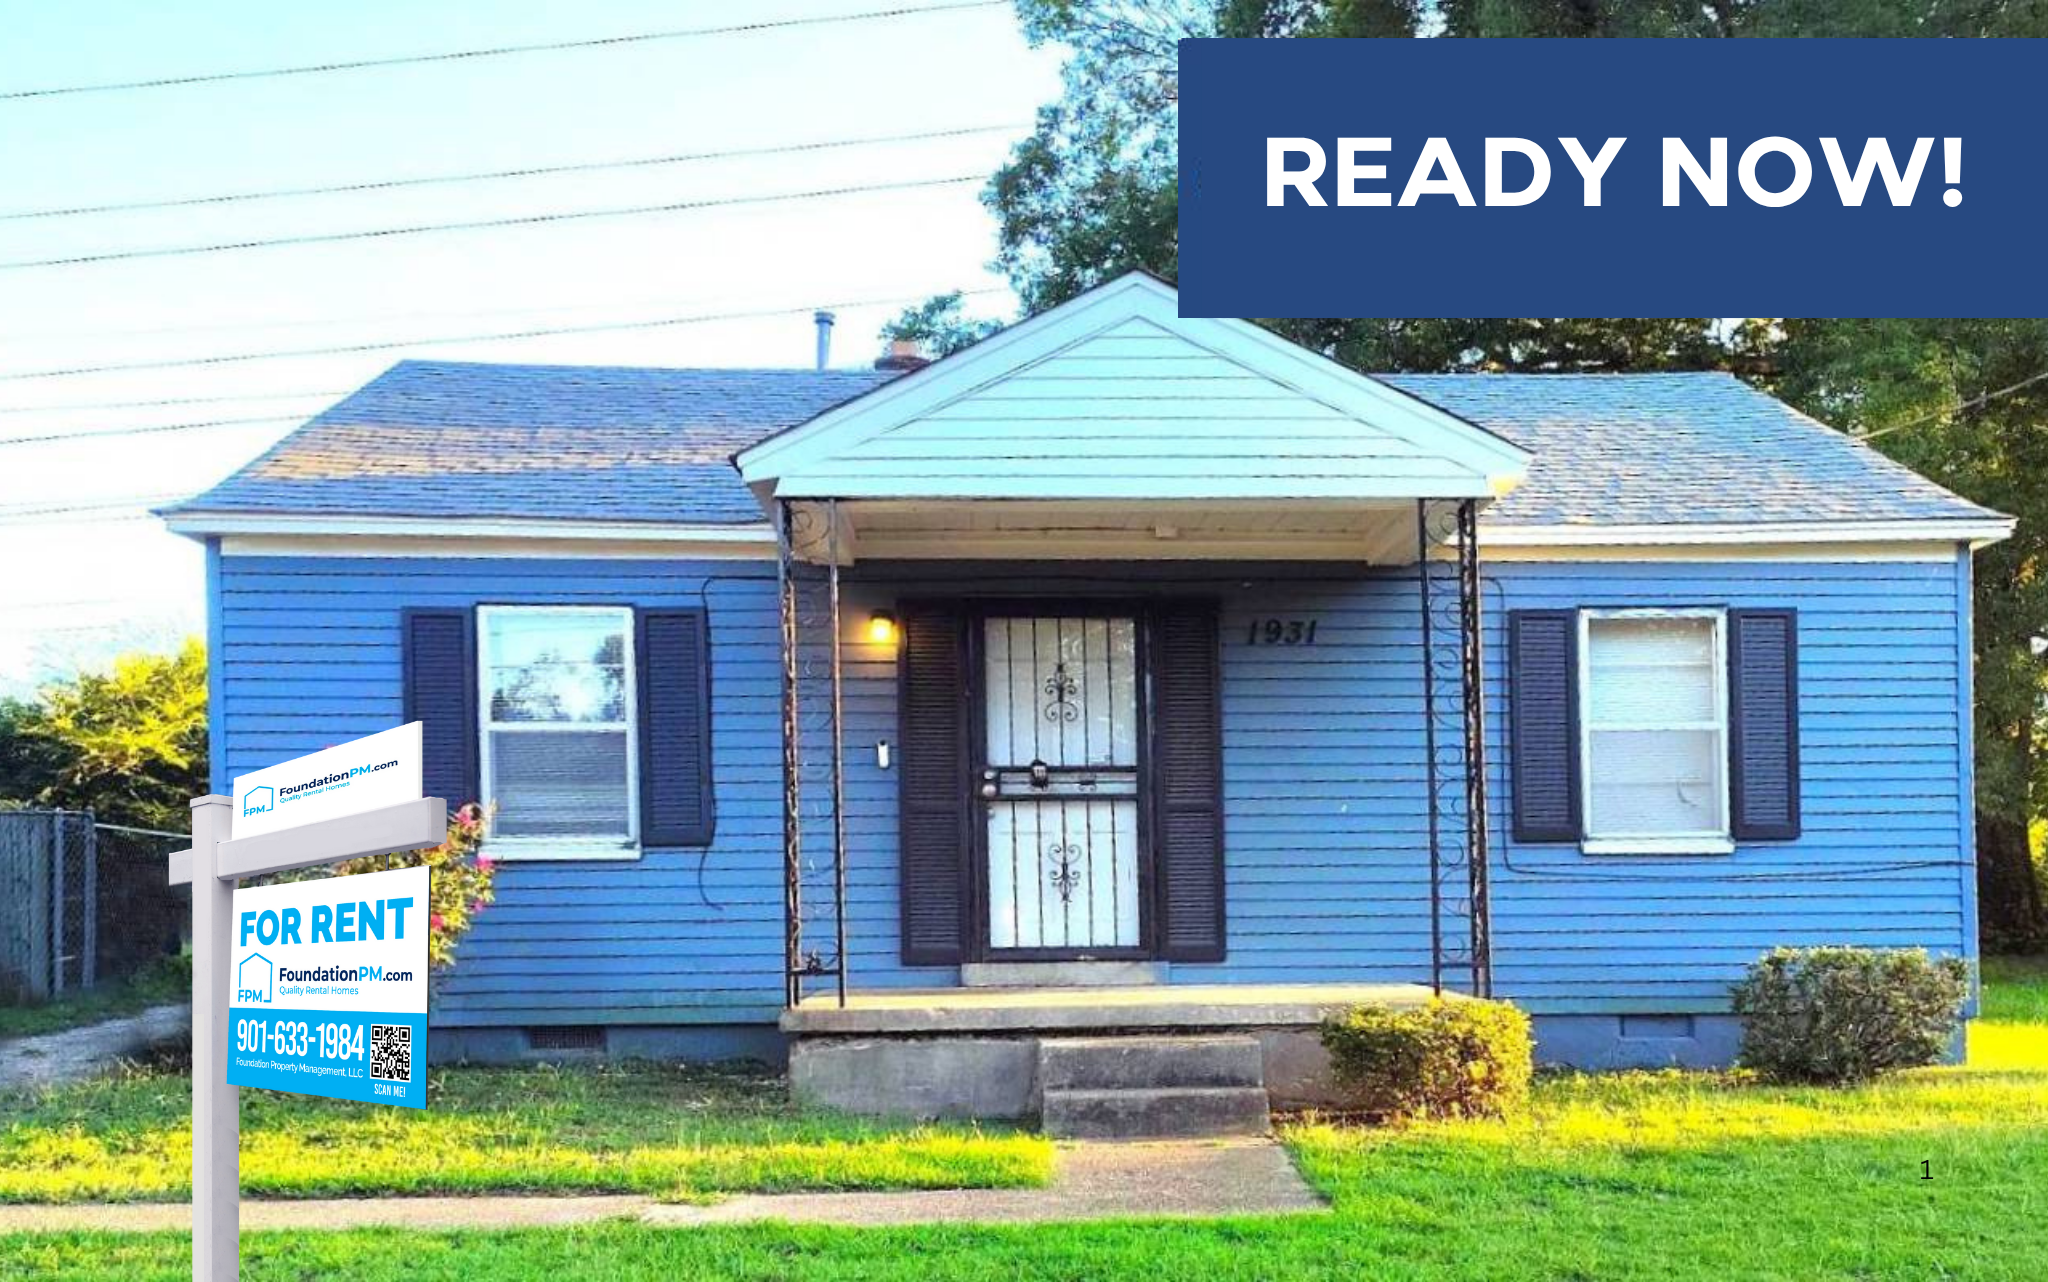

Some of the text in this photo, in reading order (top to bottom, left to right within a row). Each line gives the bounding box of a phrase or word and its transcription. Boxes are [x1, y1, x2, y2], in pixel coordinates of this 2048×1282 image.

[1247, 618, 1317, 646] 1931
[279, 759, 398, 796] FoundationPM.com
[279, 781, 350, 804] Quality Rental Homes
[243, 805, 265, 817] FPM
[240, 897, 413, 947] FOR RENT
[279, 965, 412, 983] FoundationPM.com
[238, 989, 263, 1003] FPM
[279, 985, 359, 996] Quality Rental Homes
[237, 1019, 364, 1061] 901-633-1984
[236, 1057, 363, 1078] Foundation Property Management, LLC
[374, 1083, 406, 1097] SCAN ME!
